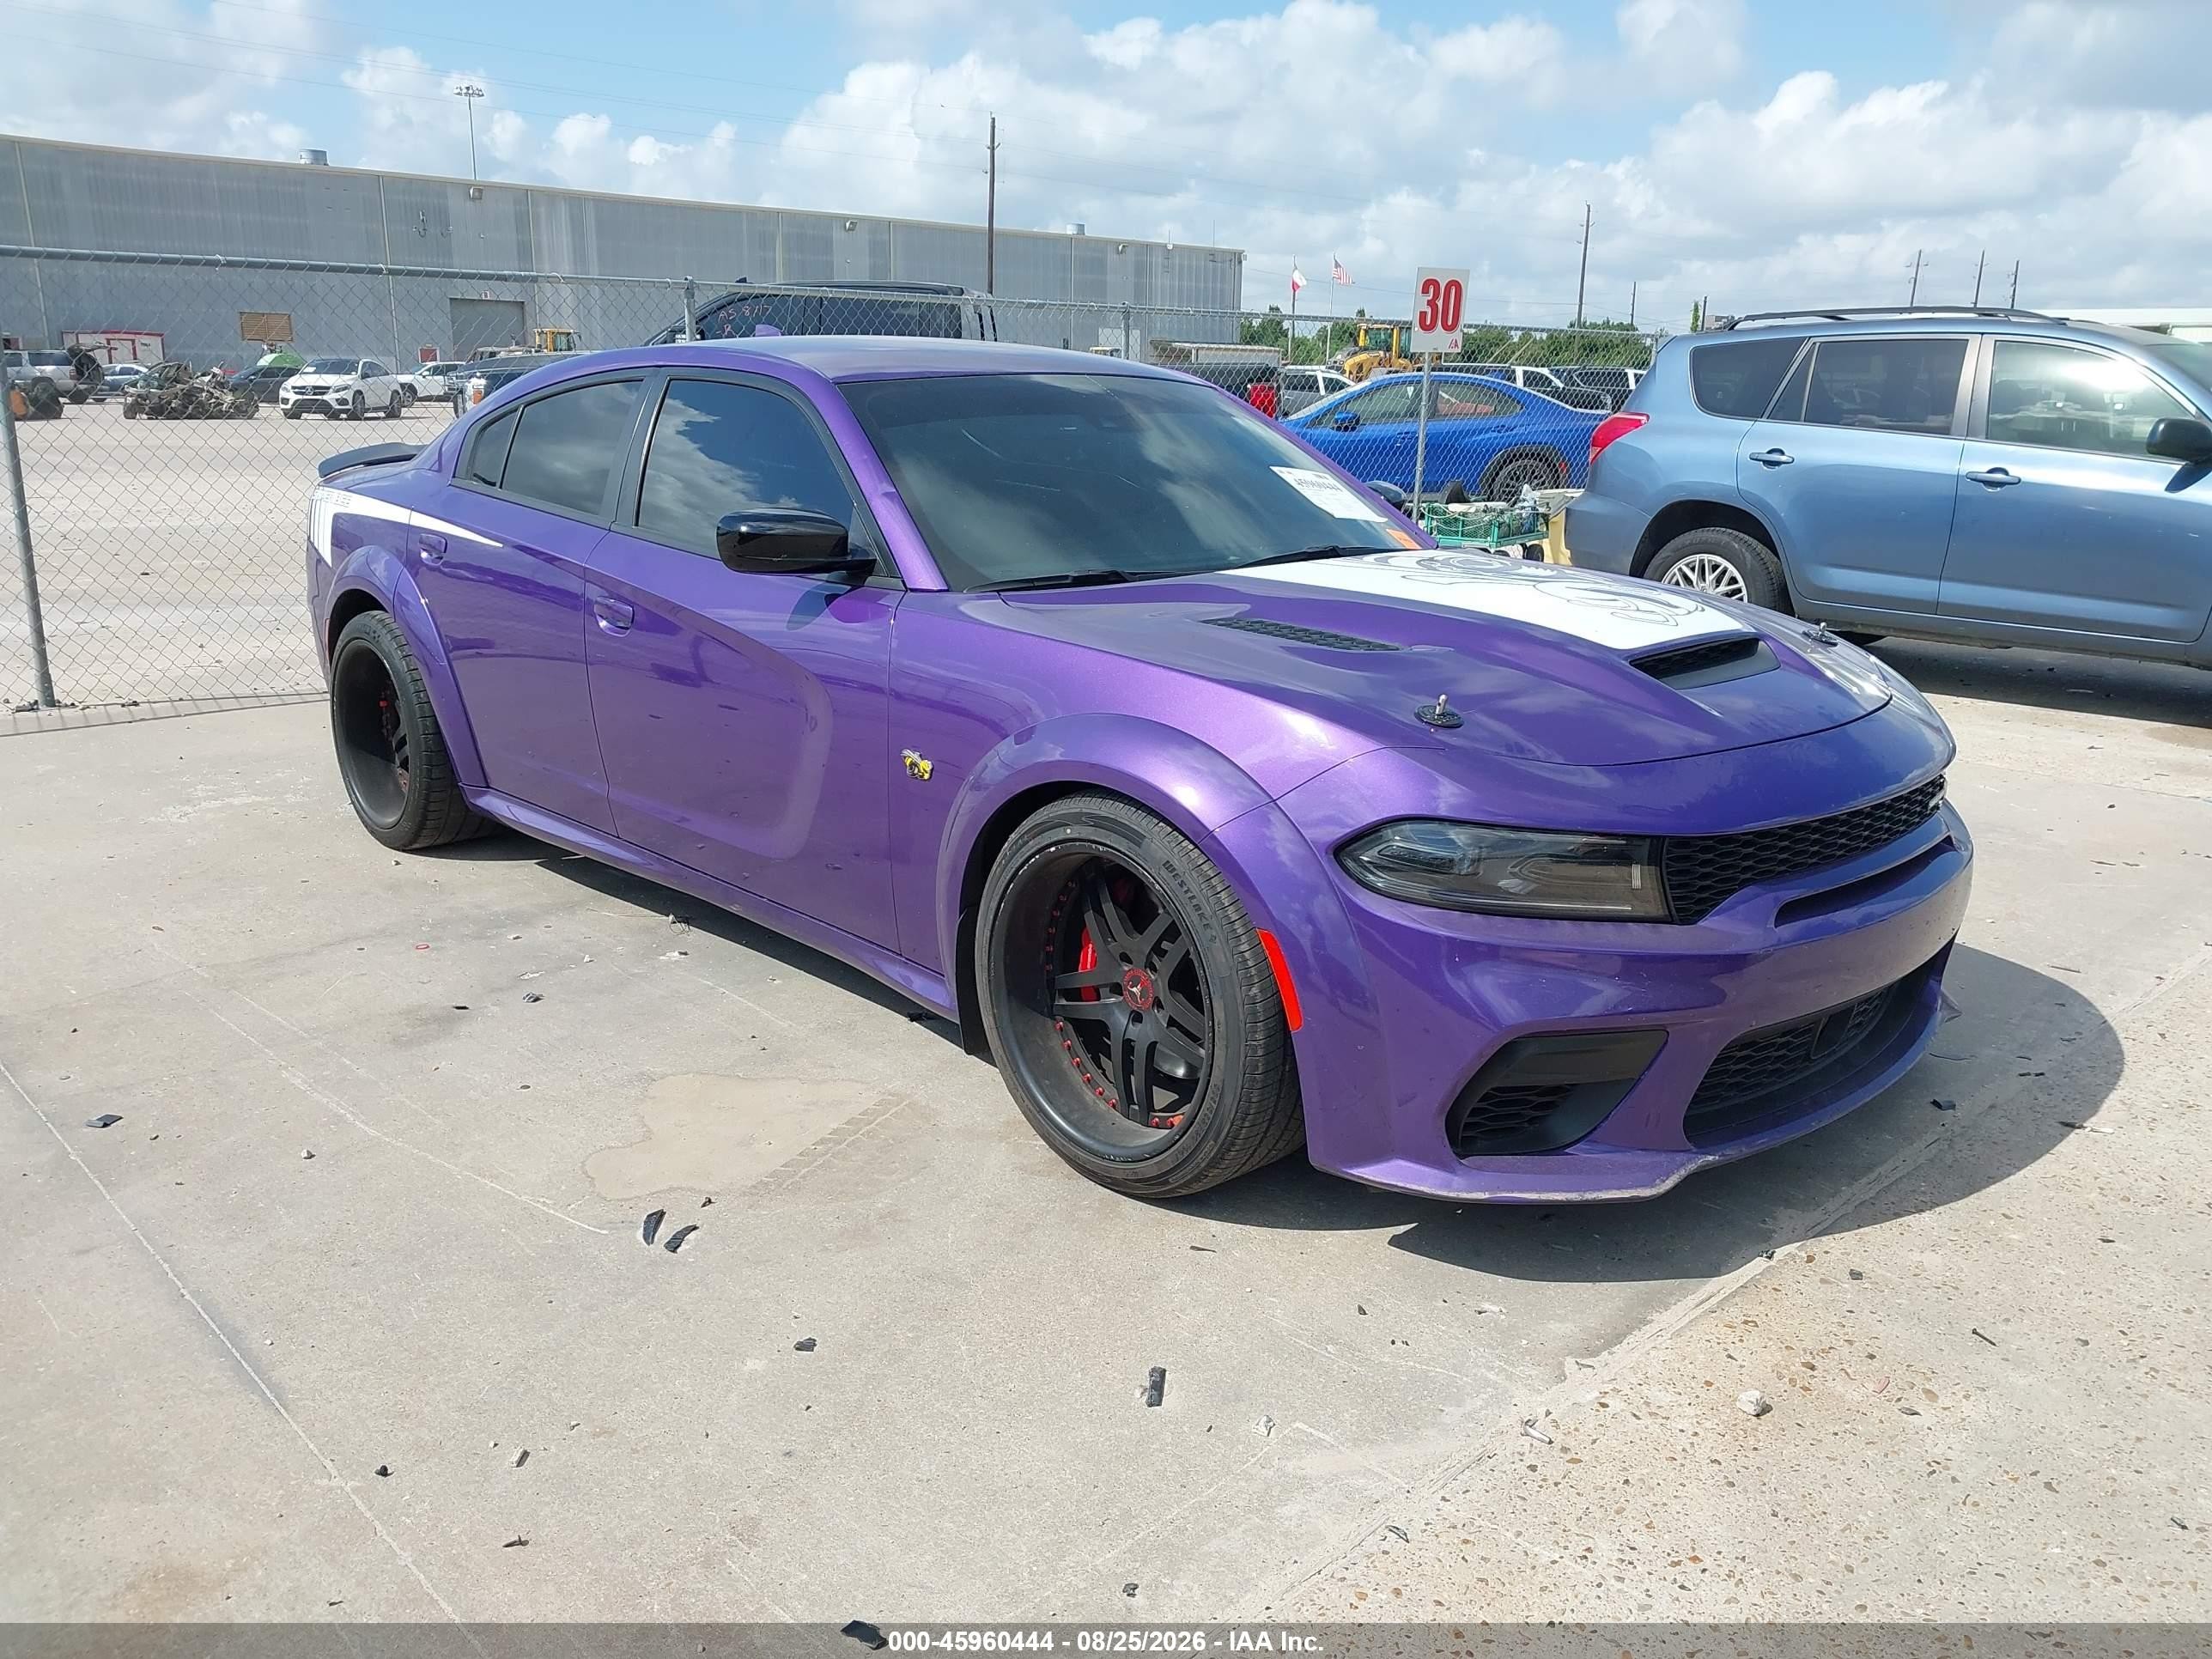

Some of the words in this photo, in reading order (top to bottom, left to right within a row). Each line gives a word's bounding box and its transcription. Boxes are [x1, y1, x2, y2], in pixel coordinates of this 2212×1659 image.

[718, 308, 737, 323] AS
[1418, 277, 1462, 332] 30
[1162, 860, 1212, 932] WESTLAKE
